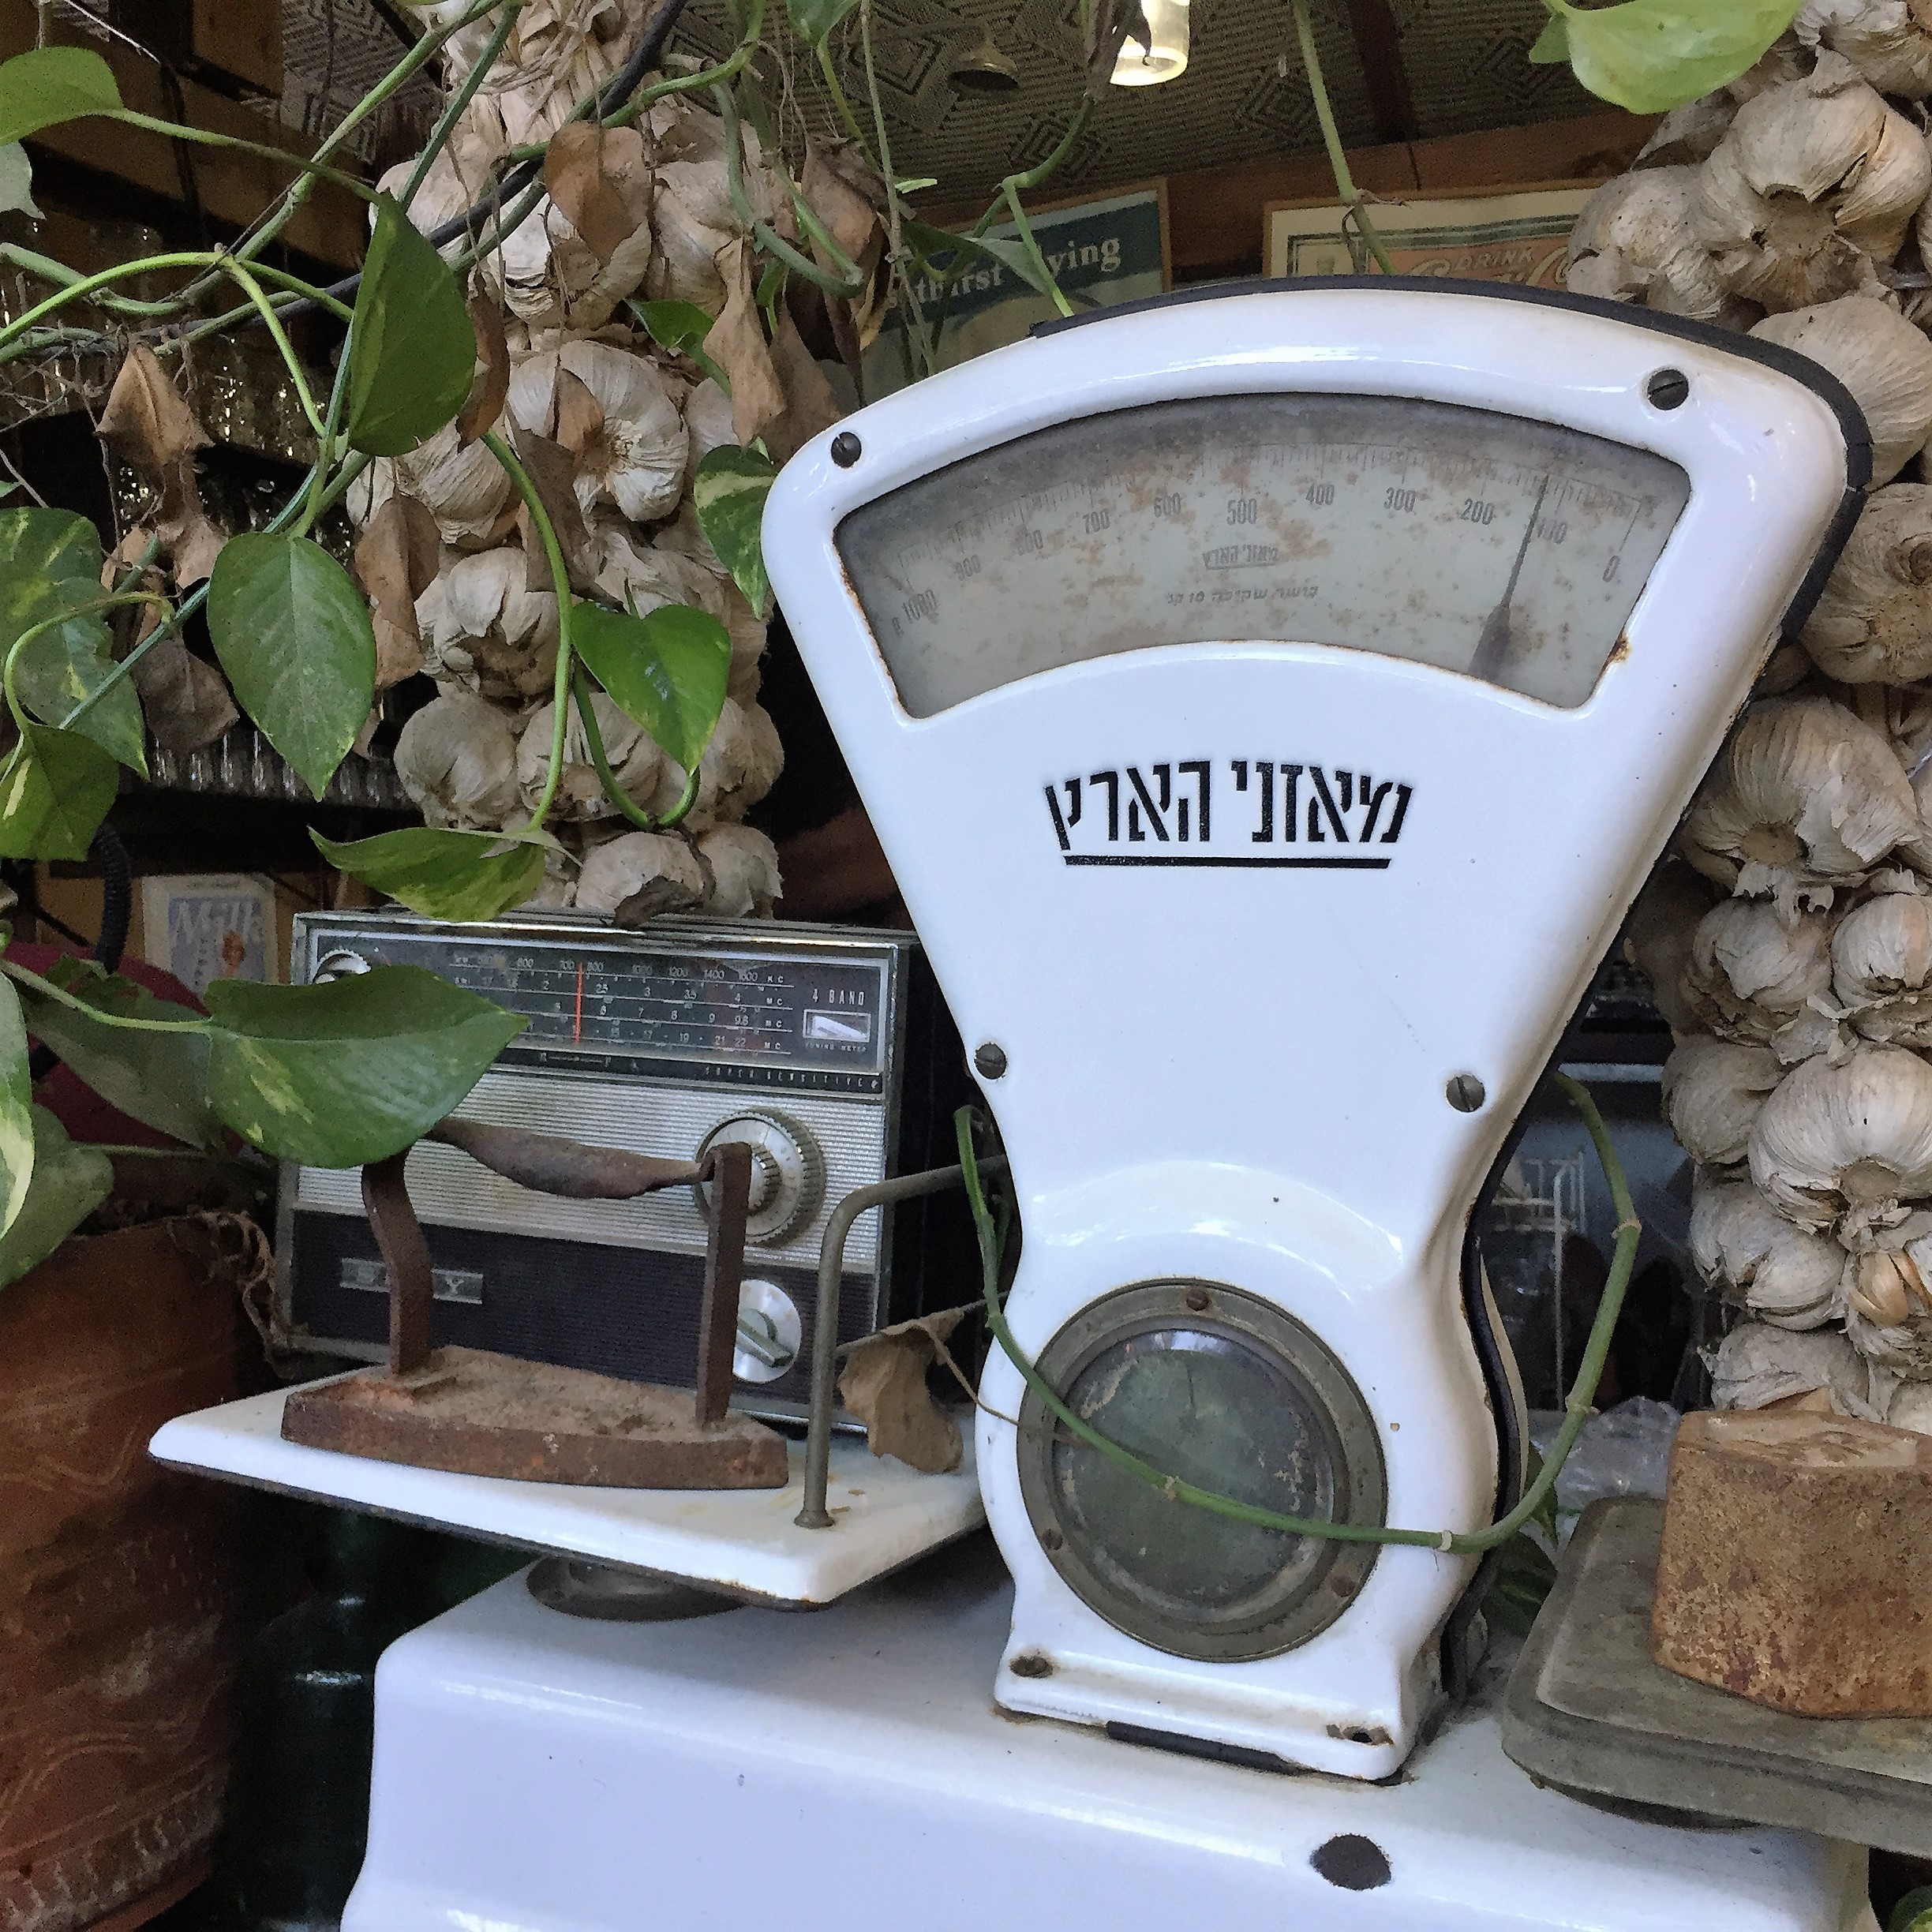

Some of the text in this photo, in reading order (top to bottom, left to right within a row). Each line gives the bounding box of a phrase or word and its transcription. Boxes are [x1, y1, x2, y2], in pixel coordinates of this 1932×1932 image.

[1037, 236, 1121, 279] ying
[1454, 245, 1533, 271] DRINK
[1083, 508, 1110, 534] 700
[1153, 492, 1181, 519] 600
[1226, 497, 1258, 526] 500
[1305, 484, 1335, 506] 400
[1383, 486, 1416, 514] 300
[1460, 497, 1495, 526] 200
[1602, 554, 1620, 582] 0
[1043, 759, 1414, 851] מאזני הארץ
[559, 960, 575, 971] 700
[644, 986, 651, 998] 3
[734, 993, 741, 1002] 4
[811, 988, 865, 1006] 4 BAND
[671, 1009, 678, 1020] 8
[709, 1013, 716, 1024] 9
